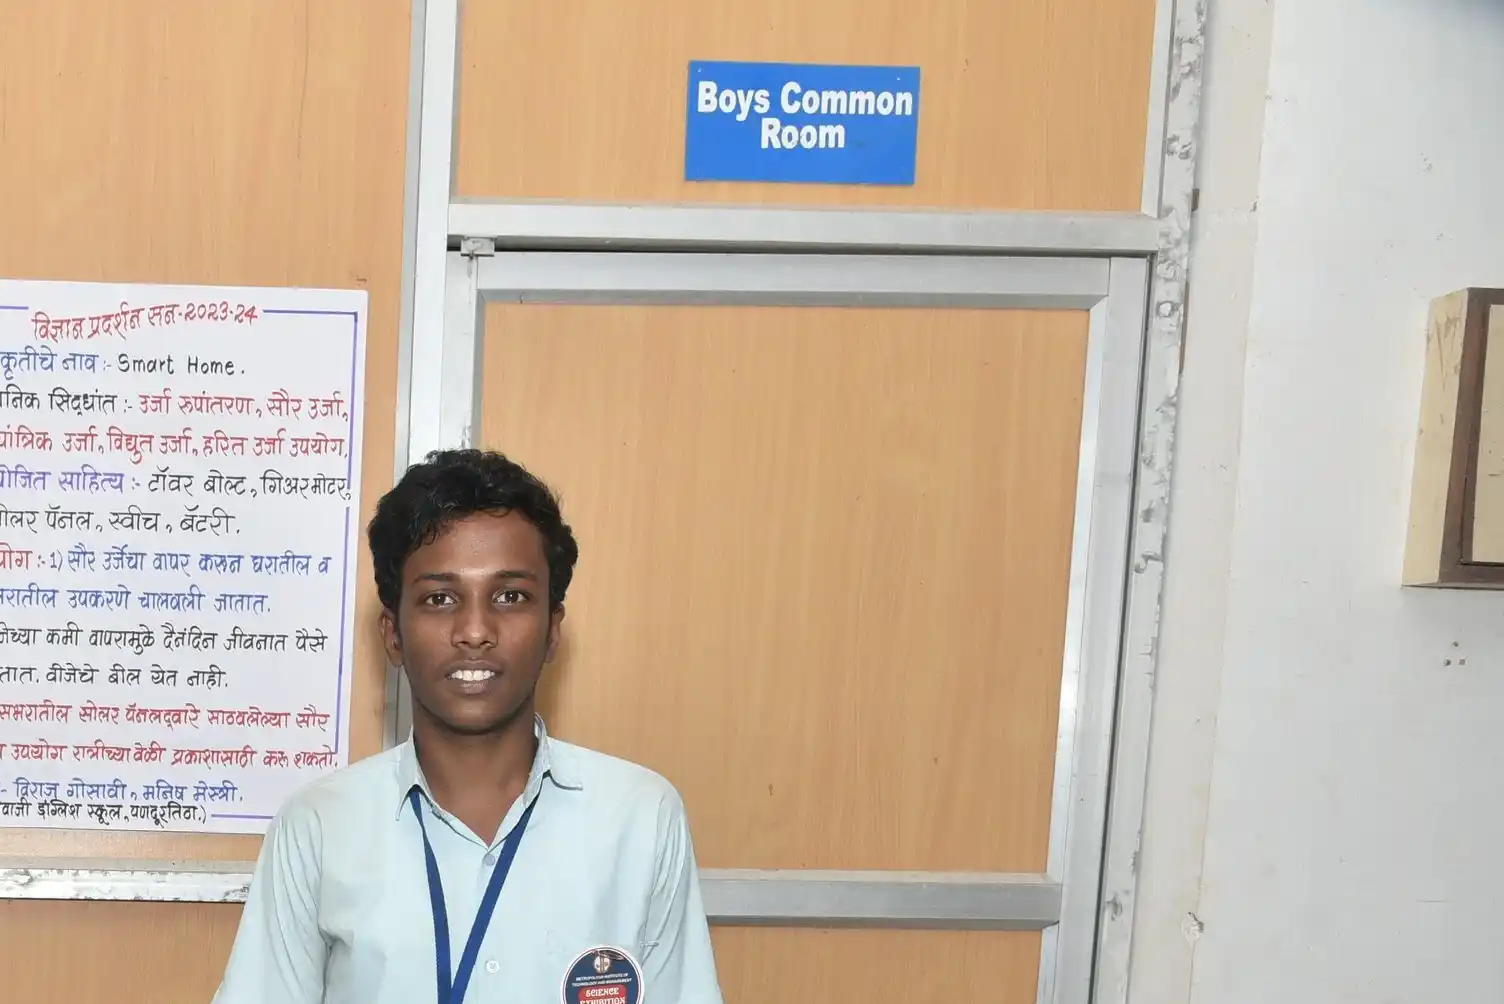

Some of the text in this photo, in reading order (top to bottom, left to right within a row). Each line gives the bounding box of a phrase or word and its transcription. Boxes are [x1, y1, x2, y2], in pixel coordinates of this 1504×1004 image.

[697, 80, 913, 121] Boys Common
[761, 117, 845, 149] Room
[31, 311, 86, 343] विज्ञान
[87, 301, 145, 340] प्रदर्शन
[118, 353, 174, 375] Smart
[139, 387, 172, 414] उर्जा
[266, 388, 302, 420] सौर
[106, 425, 155, 465] विद्युत
[202, 429, 248, 457] हरित
[253, 428, 287, 457] उर्जा
[58, 464, 125, 494] साहित्य
[148, 465, 194, 496] टॉवर
[68, 542, 96, 572] सौर
[102, 544, 147, 571] उर्जेचा
[153, 553, 191, 577] वापर
[250, 549, 312, 576] घरातील
[318, 556, 332, 575] व
[67, 583, 132, 611] उपकरणे
[138, 583, 205, 613] चालवली
[46, 621, 83, 647] कमी
[89, 624, 155, 655] वापरामुळे
[161, 622, 218, 653] दैनंदिन
[223, 625, 288, 652] जीवनात
[295, 628, 328, 653] पैसे
[46, 662, 99, 684] वीजेचे
[108, 662, 143, 686] बील
[150, 664, 179, 687] येत
[78, 699, 120, 725] सोलर
[207, 706, 291, 729] साठवलेल्या
[295, 704, 330, 732] सौर
[11, 738, 68, 761] उपयोग
[133, 740, 166, 763] वेळी
[170, 744, 258, 770] प्रकाशासाठी
[142, 779, 188, 802] मनिष
[586, 987, 619, 997] SCIENCE
